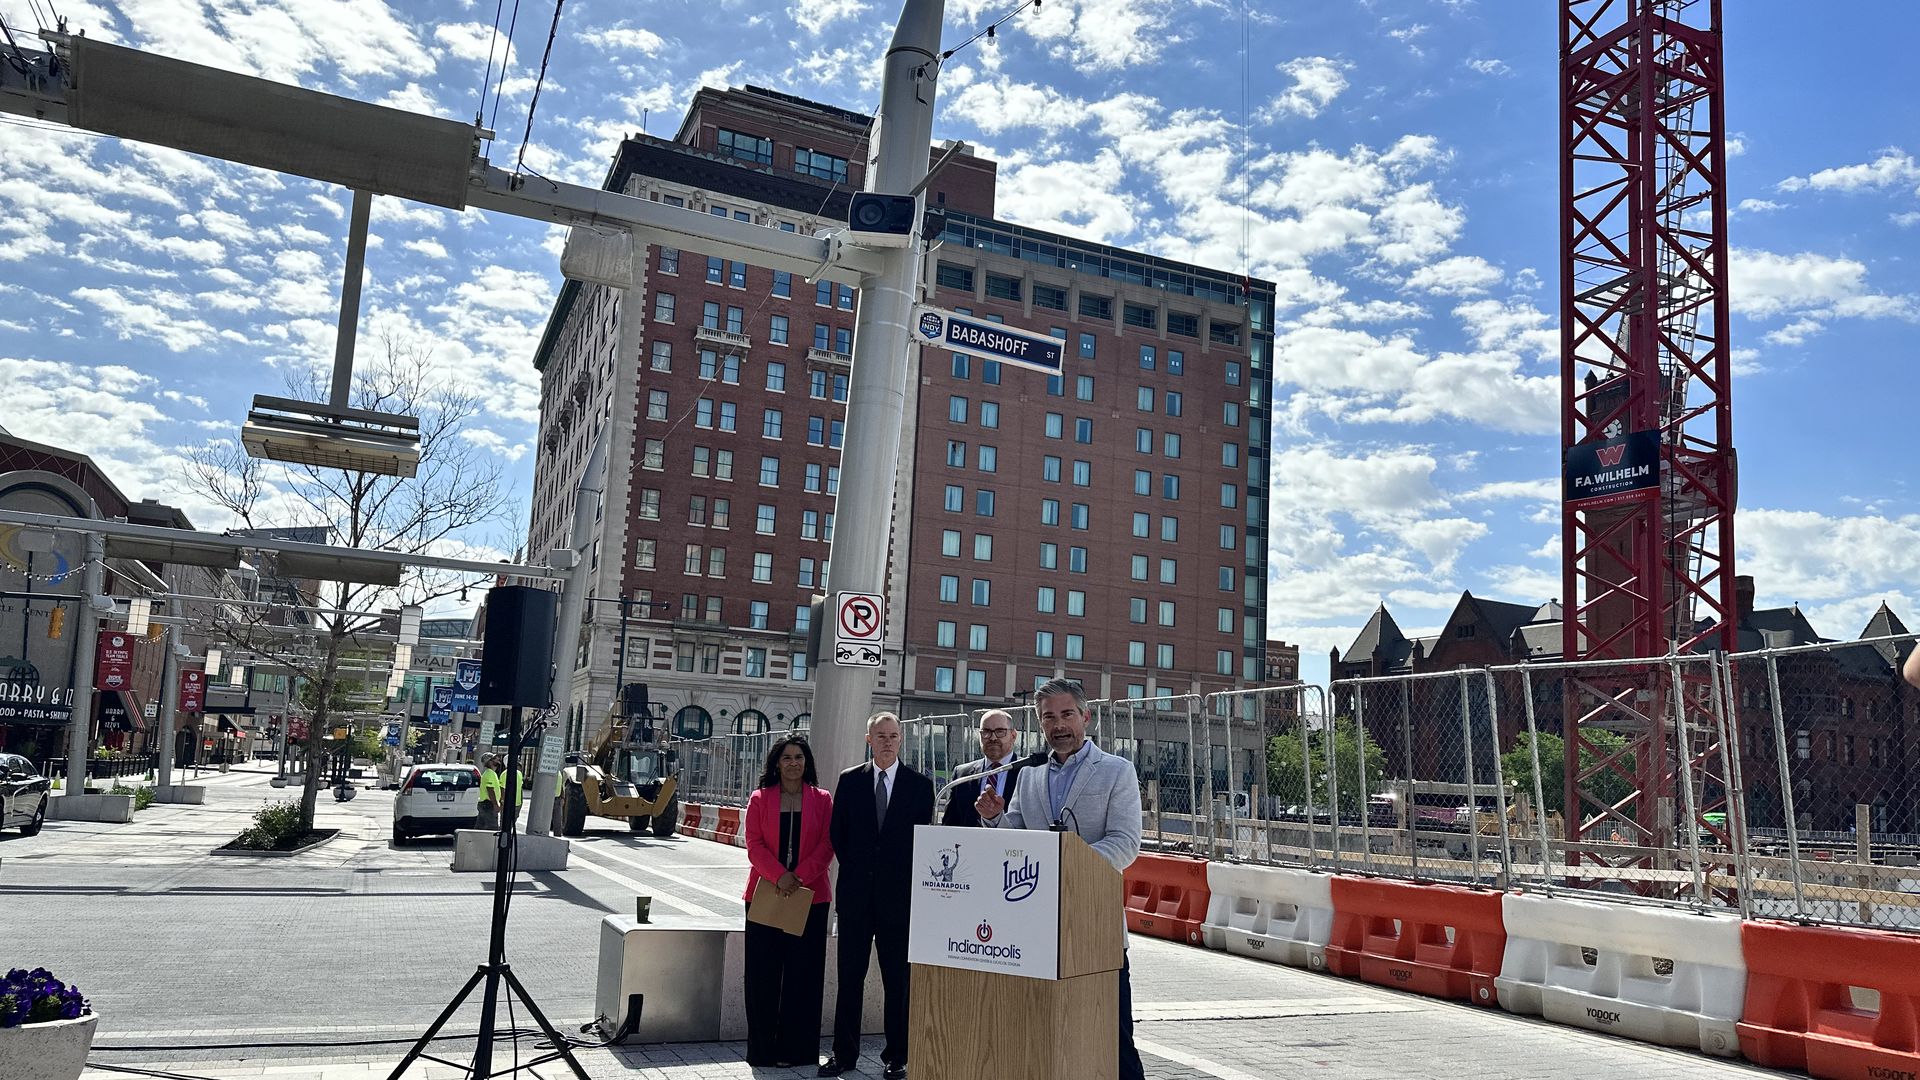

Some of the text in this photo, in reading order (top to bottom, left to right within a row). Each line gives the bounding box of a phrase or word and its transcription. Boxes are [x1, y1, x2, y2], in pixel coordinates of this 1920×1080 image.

[921, 323, 940, 332] INDY
[951, 324, 1055, 360] BABASHOFF ST
[1590, 481, 1633, 492] CONSTRUCTION
[51, 687, 60, 705] &
[23, 708, 45, 719] PASTA
[1005, 849, 1024, 857] VISIT
[1003, 855, 1040, 902] Indy
[922, 881, 970, 890] INDIANAPOLIS
[948, 938, 1021, 960] Indianapolis
[1586, 1007, 1621, 1023] YODOCK
